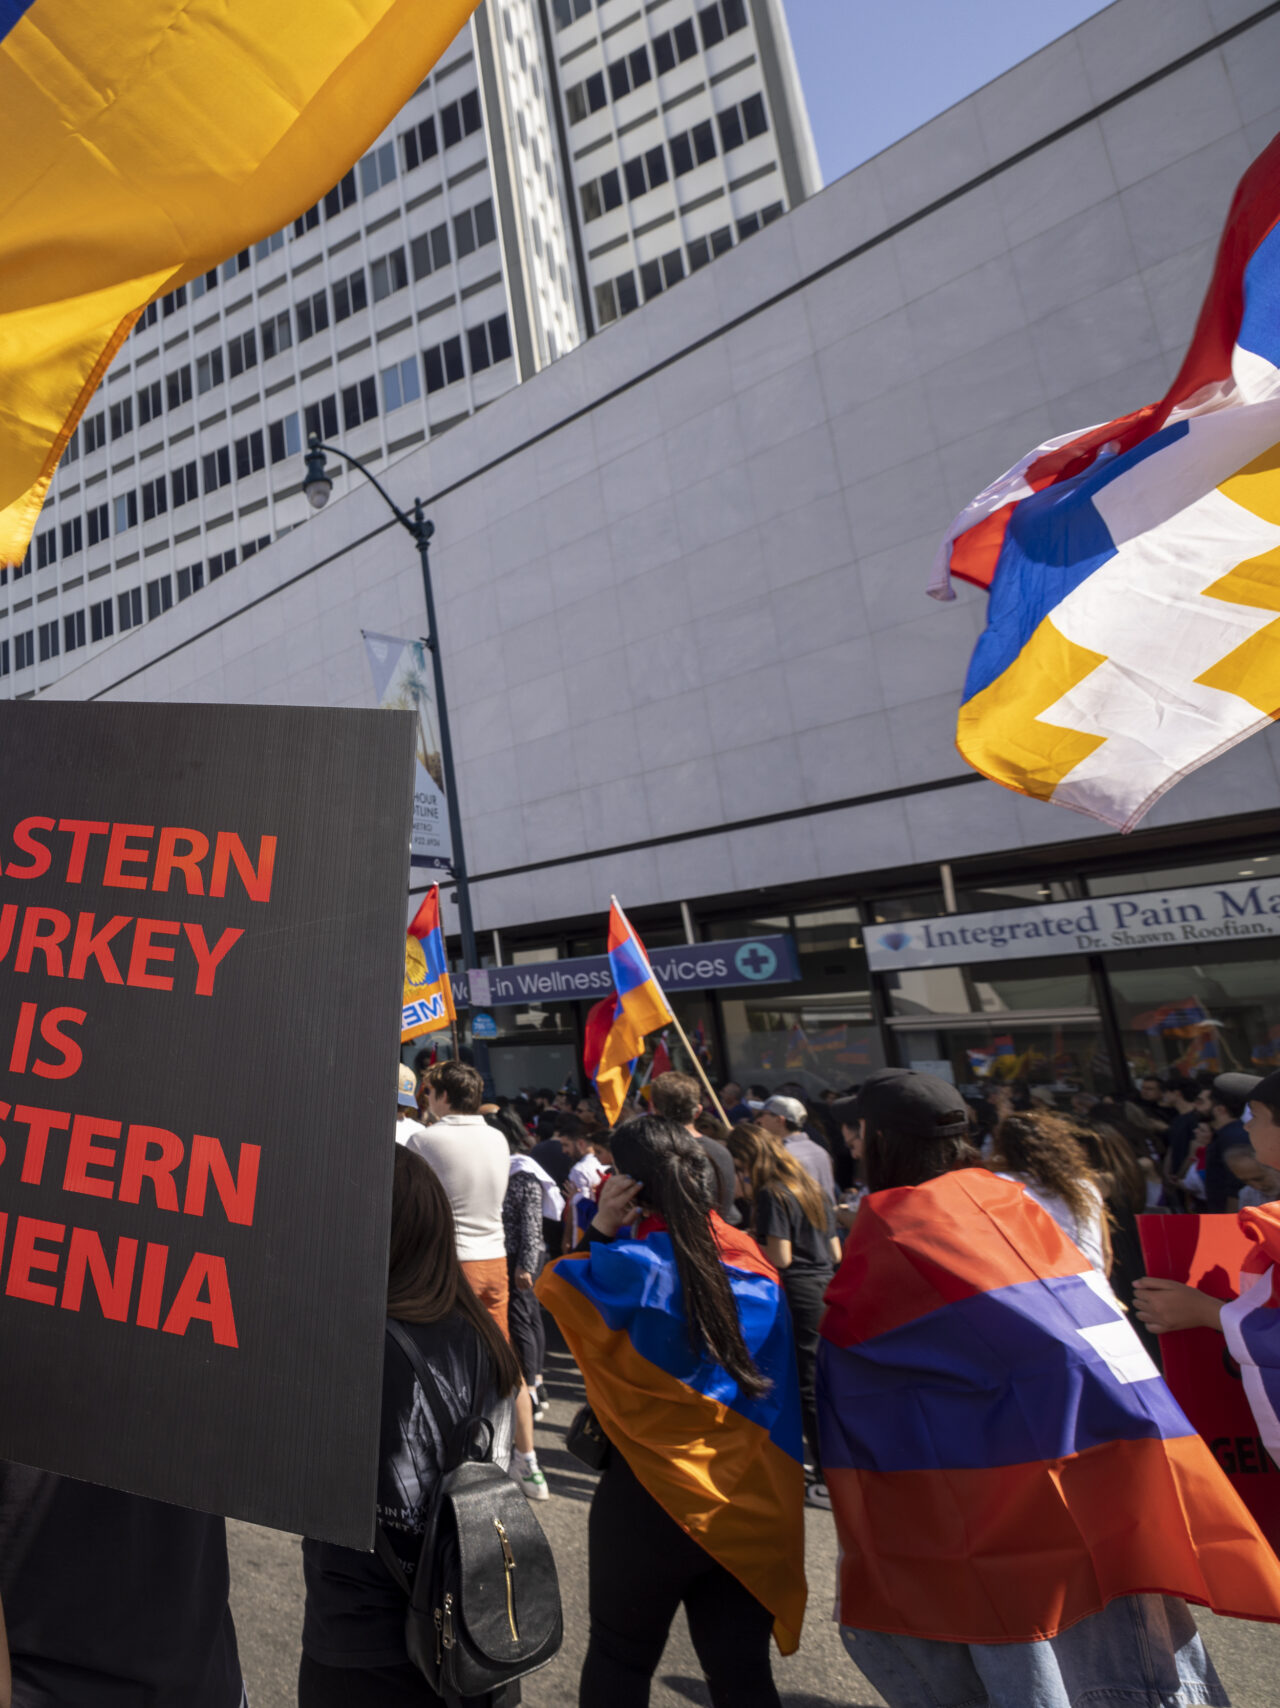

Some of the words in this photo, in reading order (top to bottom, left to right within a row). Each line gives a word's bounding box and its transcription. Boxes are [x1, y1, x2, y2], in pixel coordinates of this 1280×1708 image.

[921, 905, 1100, 949] Integrated
[1109, 897, 1206, 930] Pain
[1075, 934, 1107, 950] Dr.
[1111, 930, 1176, 947] Shawn
[517, 969, 612, 995] Wellness
[651, 957, 728, 982] rvices
[9, 1001, 88, 1080] IS
